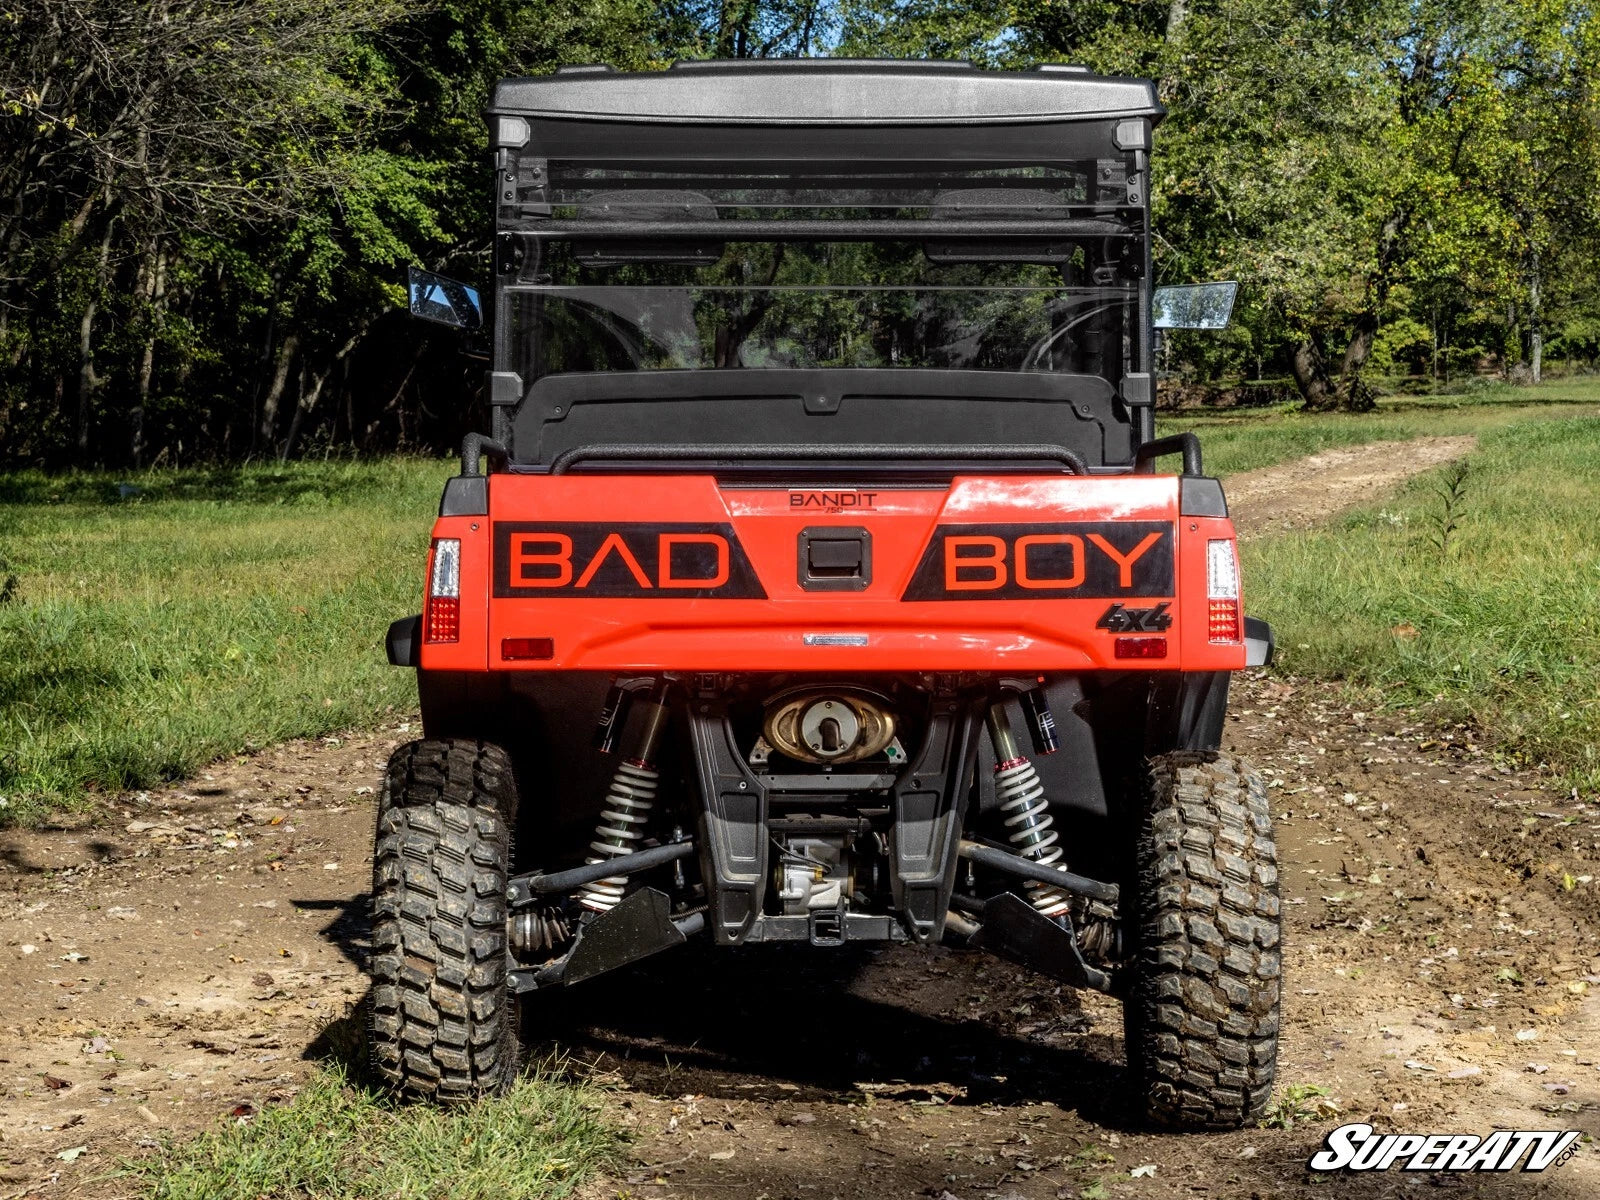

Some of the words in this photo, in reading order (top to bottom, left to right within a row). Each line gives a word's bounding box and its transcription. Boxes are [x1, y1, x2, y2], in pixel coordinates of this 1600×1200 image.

[790, 493, 877, 507] BANDIT
[824, 506, 844, 514] 750
[509, 532, 730, 590] BAD
[944, 532, 1164, 591] BOY
